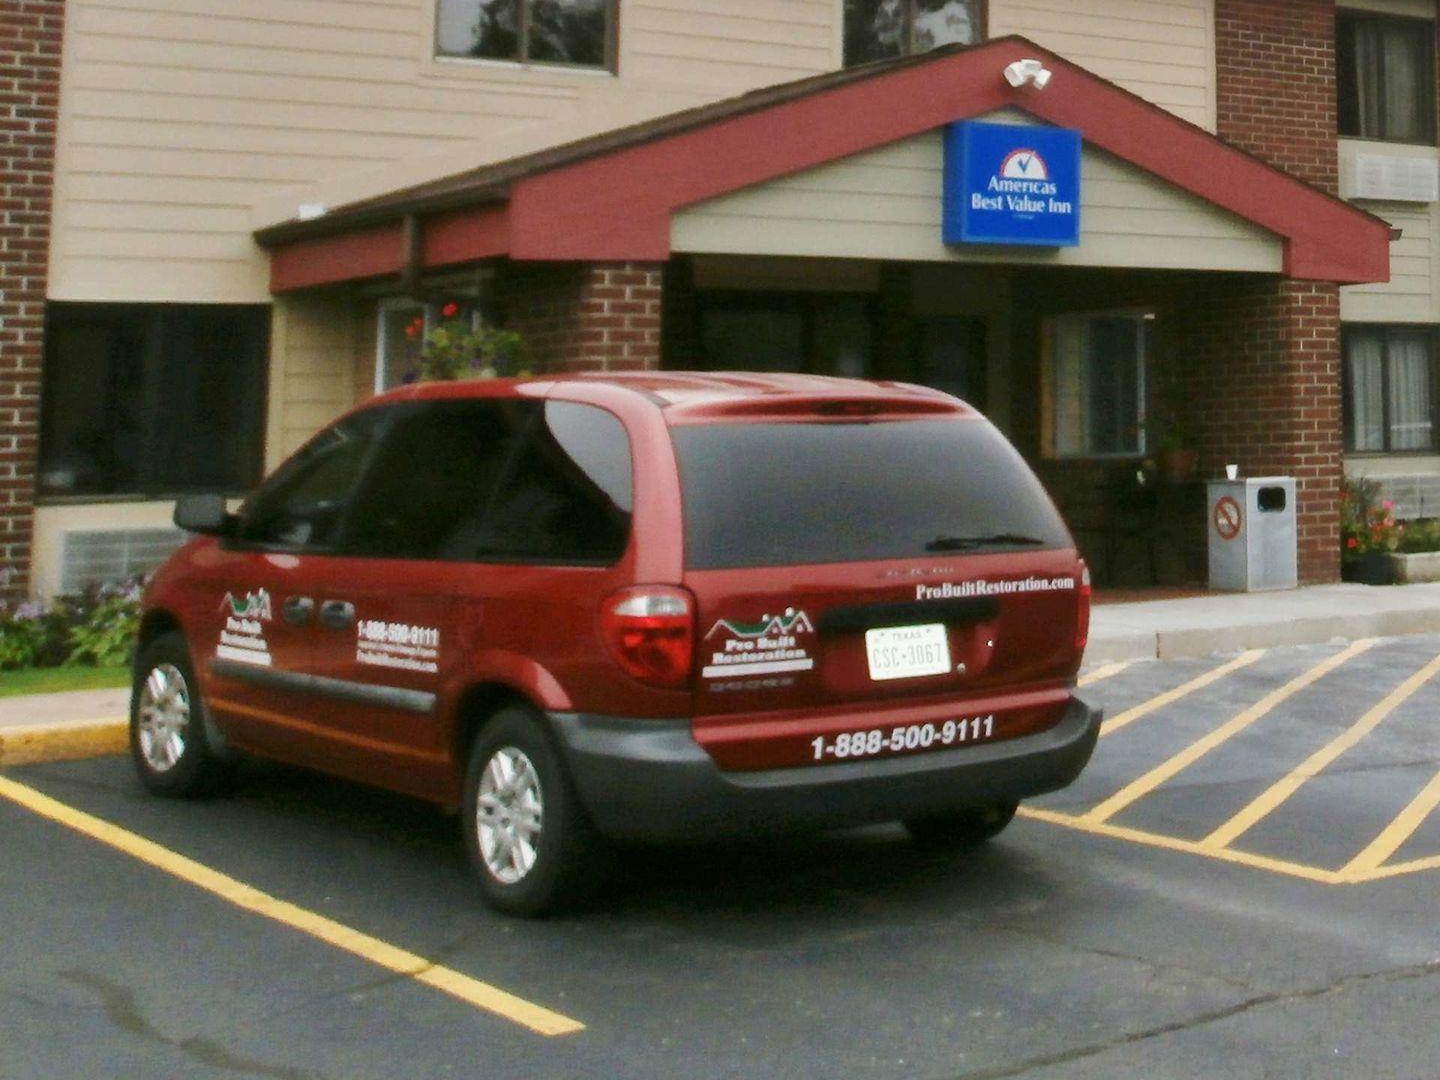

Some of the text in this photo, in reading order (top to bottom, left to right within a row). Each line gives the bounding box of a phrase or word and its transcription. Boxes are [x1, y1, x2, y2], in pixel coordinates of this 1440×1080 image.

[987, 175, 1057, 195] Americas
[971, 193, 1072, 214] Best Value Inn
[915, 576, 1075, 600] ProBuiltRestoration.com
[725, 639, 755, 652] Pro
[892, 631, 922, 641] TEXAS
[712, 649, 806, 664] Restoration
[811, 715, 994, 760] 1-888-500-9111
